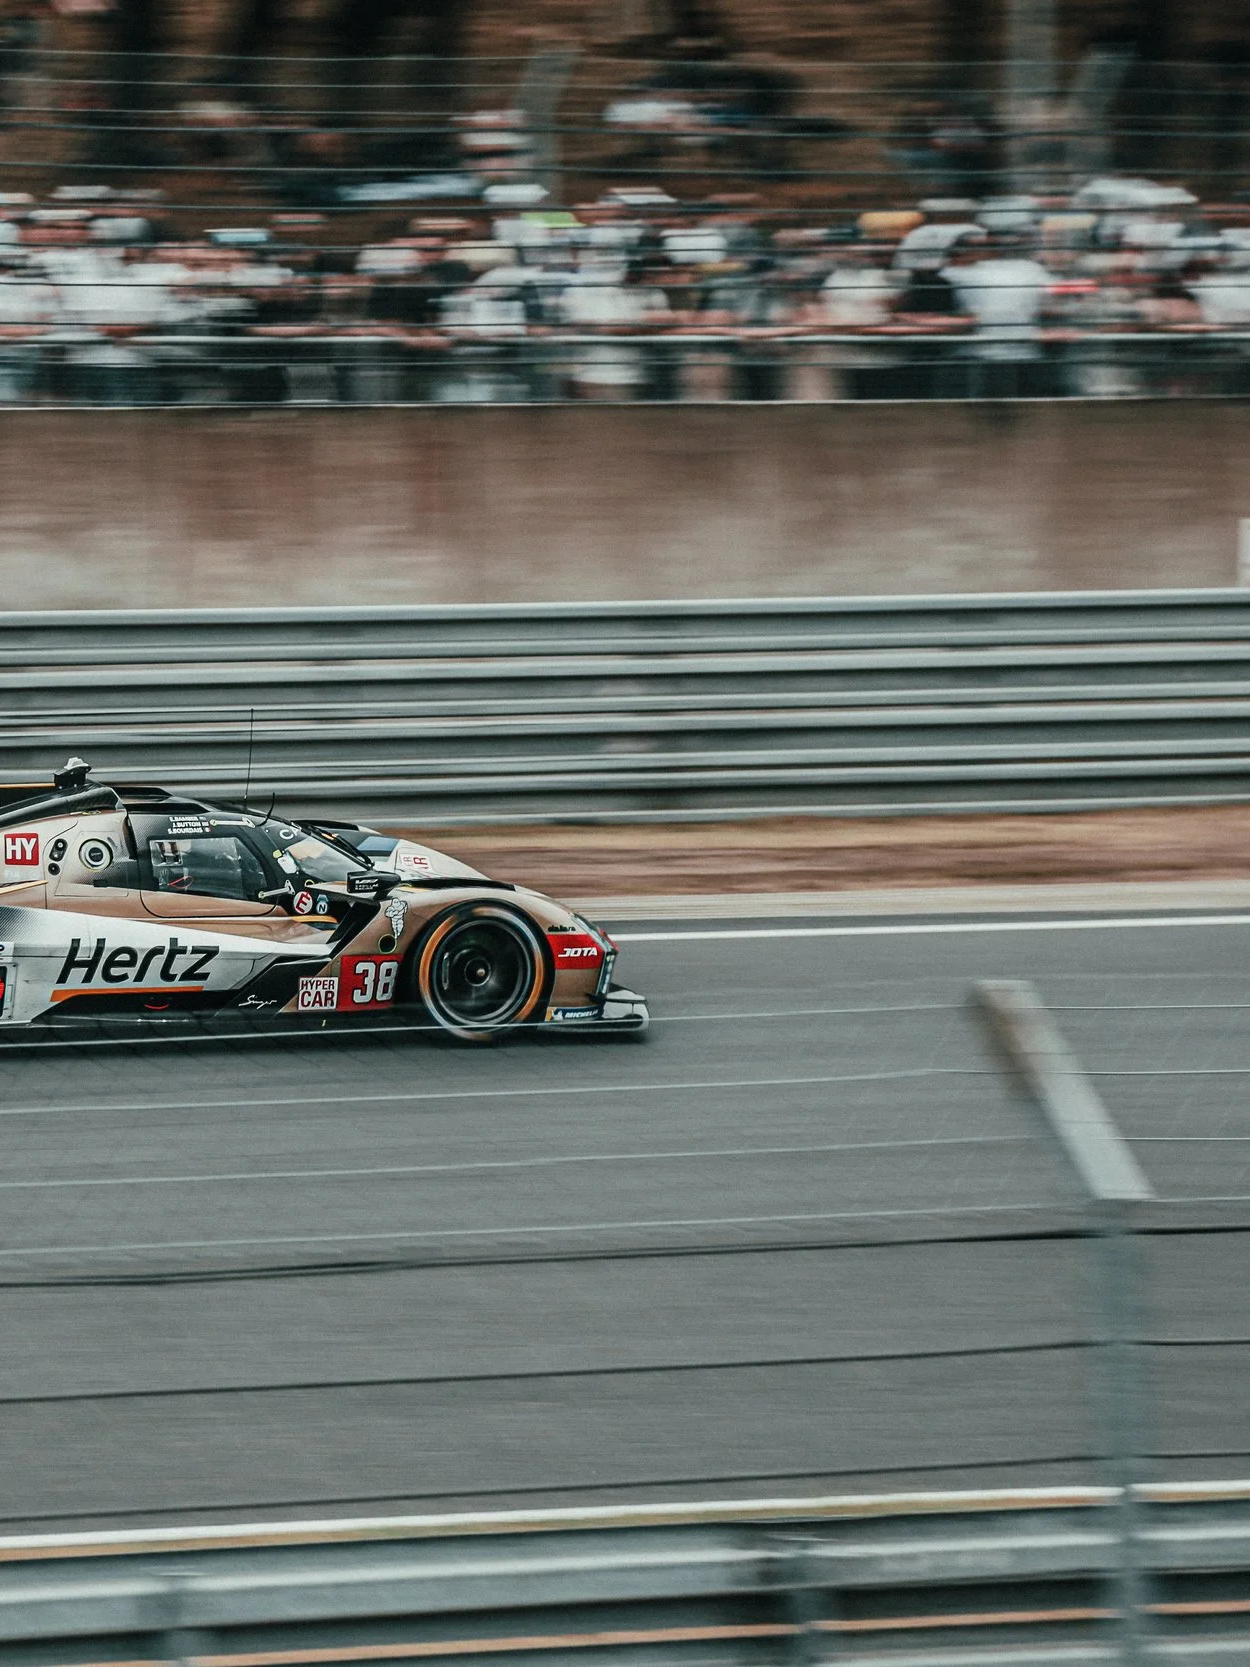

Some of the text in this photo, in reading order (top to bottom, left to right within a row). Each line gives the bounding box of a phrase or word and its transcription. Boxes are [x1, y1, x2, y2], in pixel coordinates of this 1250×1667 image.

[5, 837, 37, 860] HY
[56, 937, 220, 985] Hertz
[557, 946, 598, 958] JOTA
[300, 979, 335, 991] HYPER
[353, 961, 399, 1004] 38
[300, 990, 336, 1008] CAR
